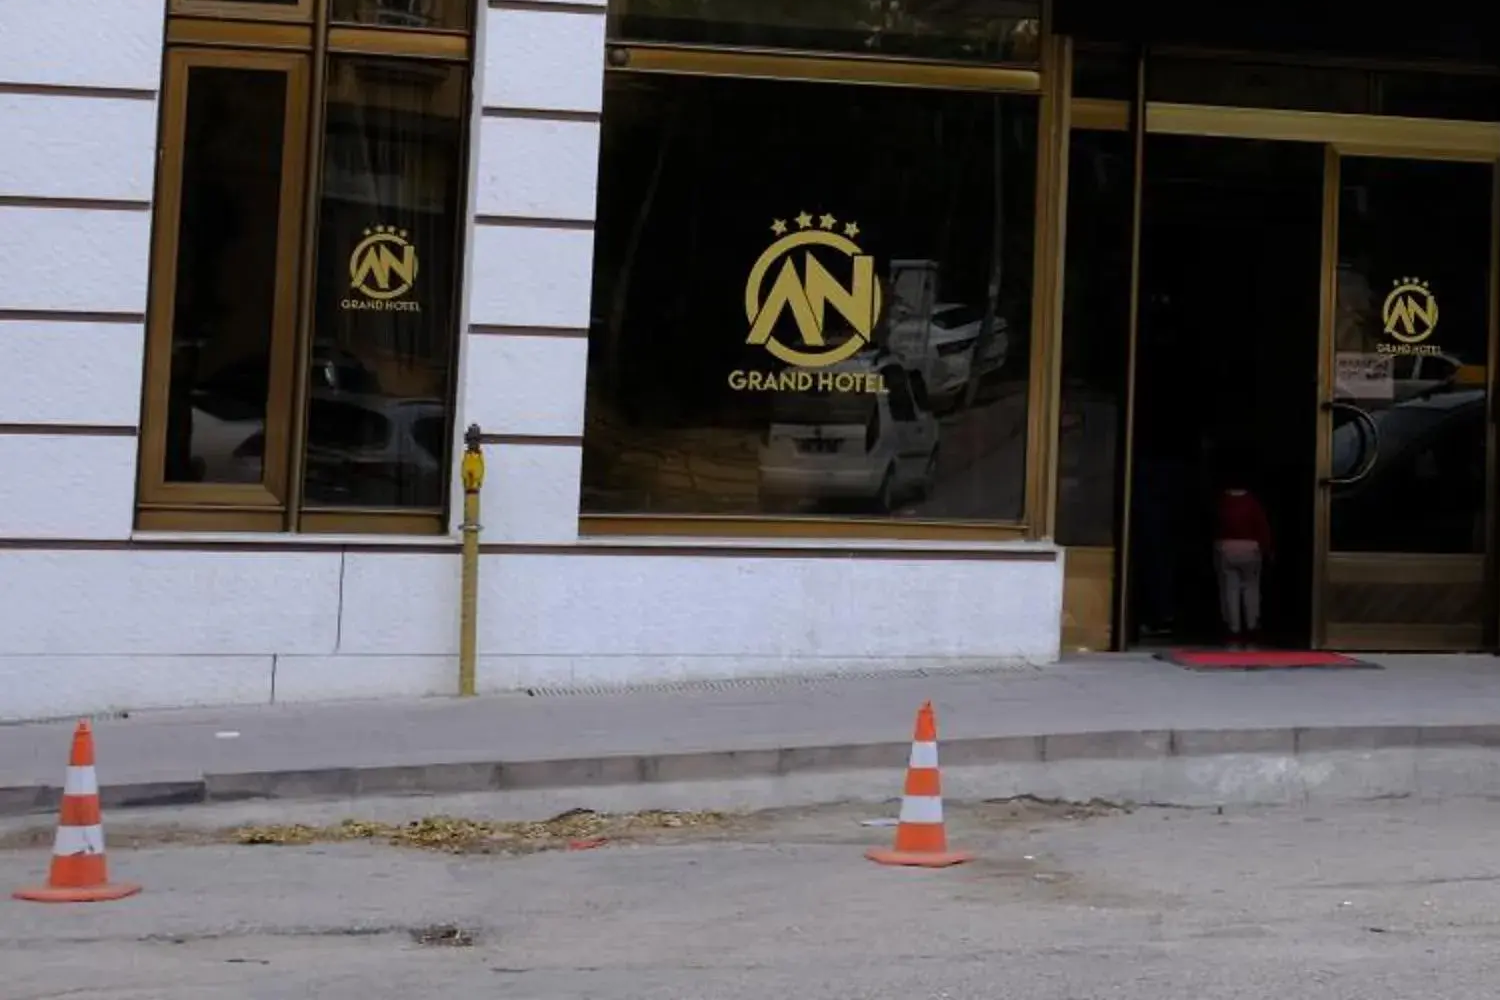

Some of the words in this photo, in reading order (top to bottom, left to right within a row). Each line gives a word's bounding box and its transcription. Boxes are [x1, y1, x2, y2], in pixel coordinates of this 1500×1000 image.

[341, 299, 383, 310] GRAND
[385, 300, 420, 312] HOTEL
[1376, 343, 1410, 354] GRAND
[1412, 345, 1442, 356] HOTEL
[728, 369, 813, 391] GRAND
[818, 372, 890, 394] HOTEL
